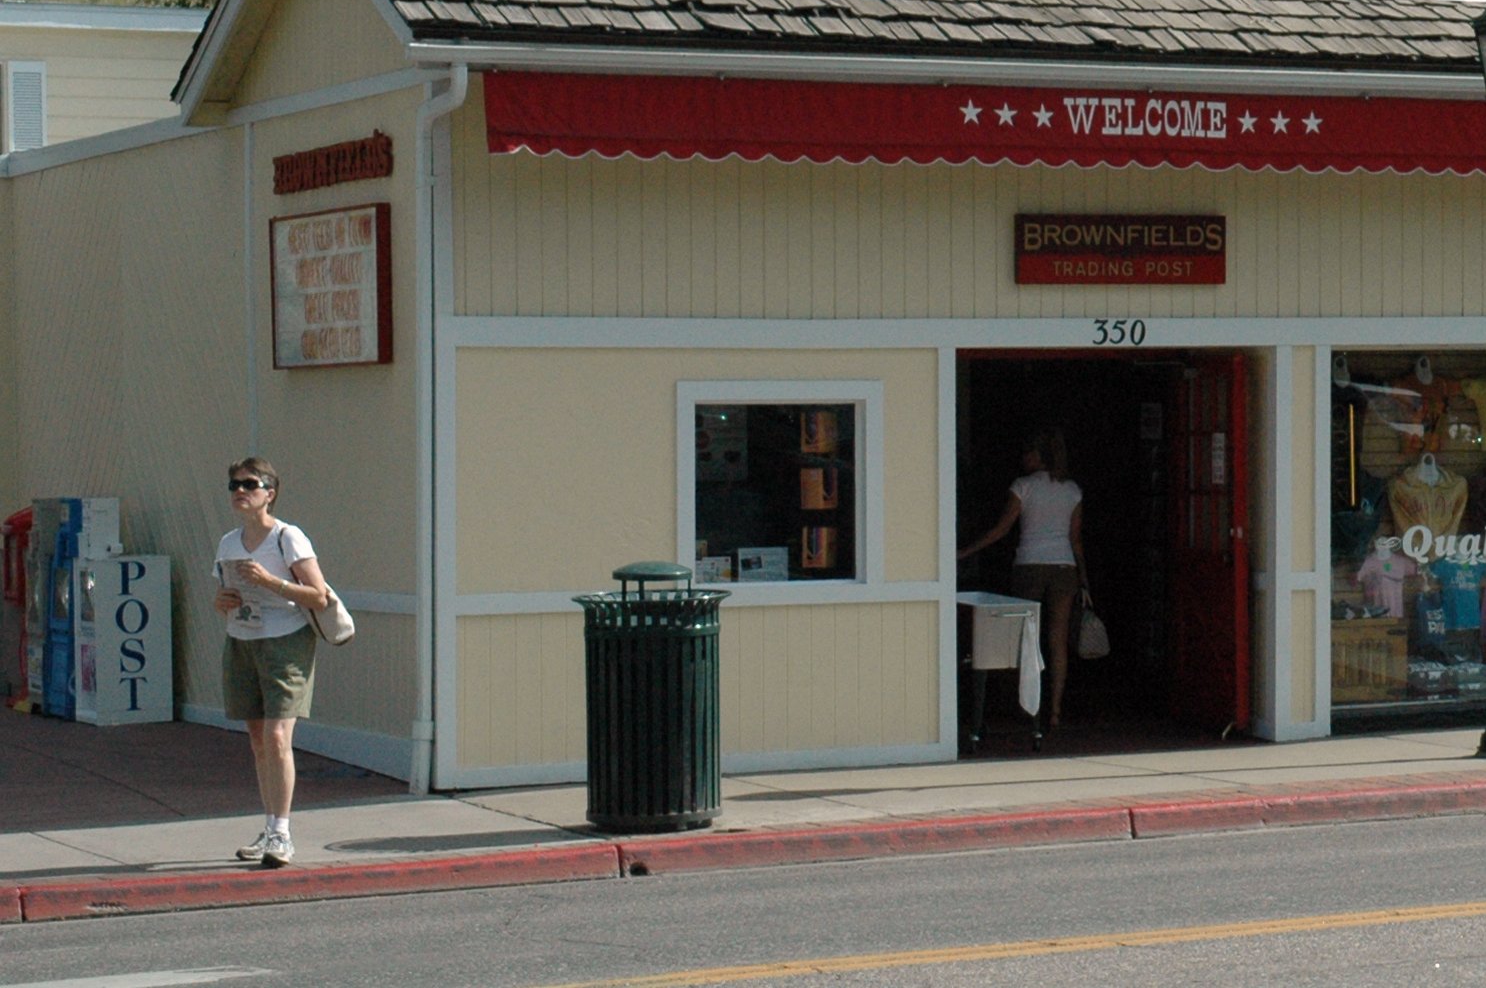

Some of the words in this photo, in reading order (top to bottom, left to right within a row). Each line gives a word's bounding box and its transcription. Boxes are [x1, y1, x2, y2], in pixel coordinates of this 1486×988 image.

[1063, 98, 1226, 138] WELCOME
[1053, 261, 1134, 277] TRADING
[1145, 261, 1193, 277] POST
[1093, 319, 1146, 346] 350
[115, 560, 150, 712] POST
